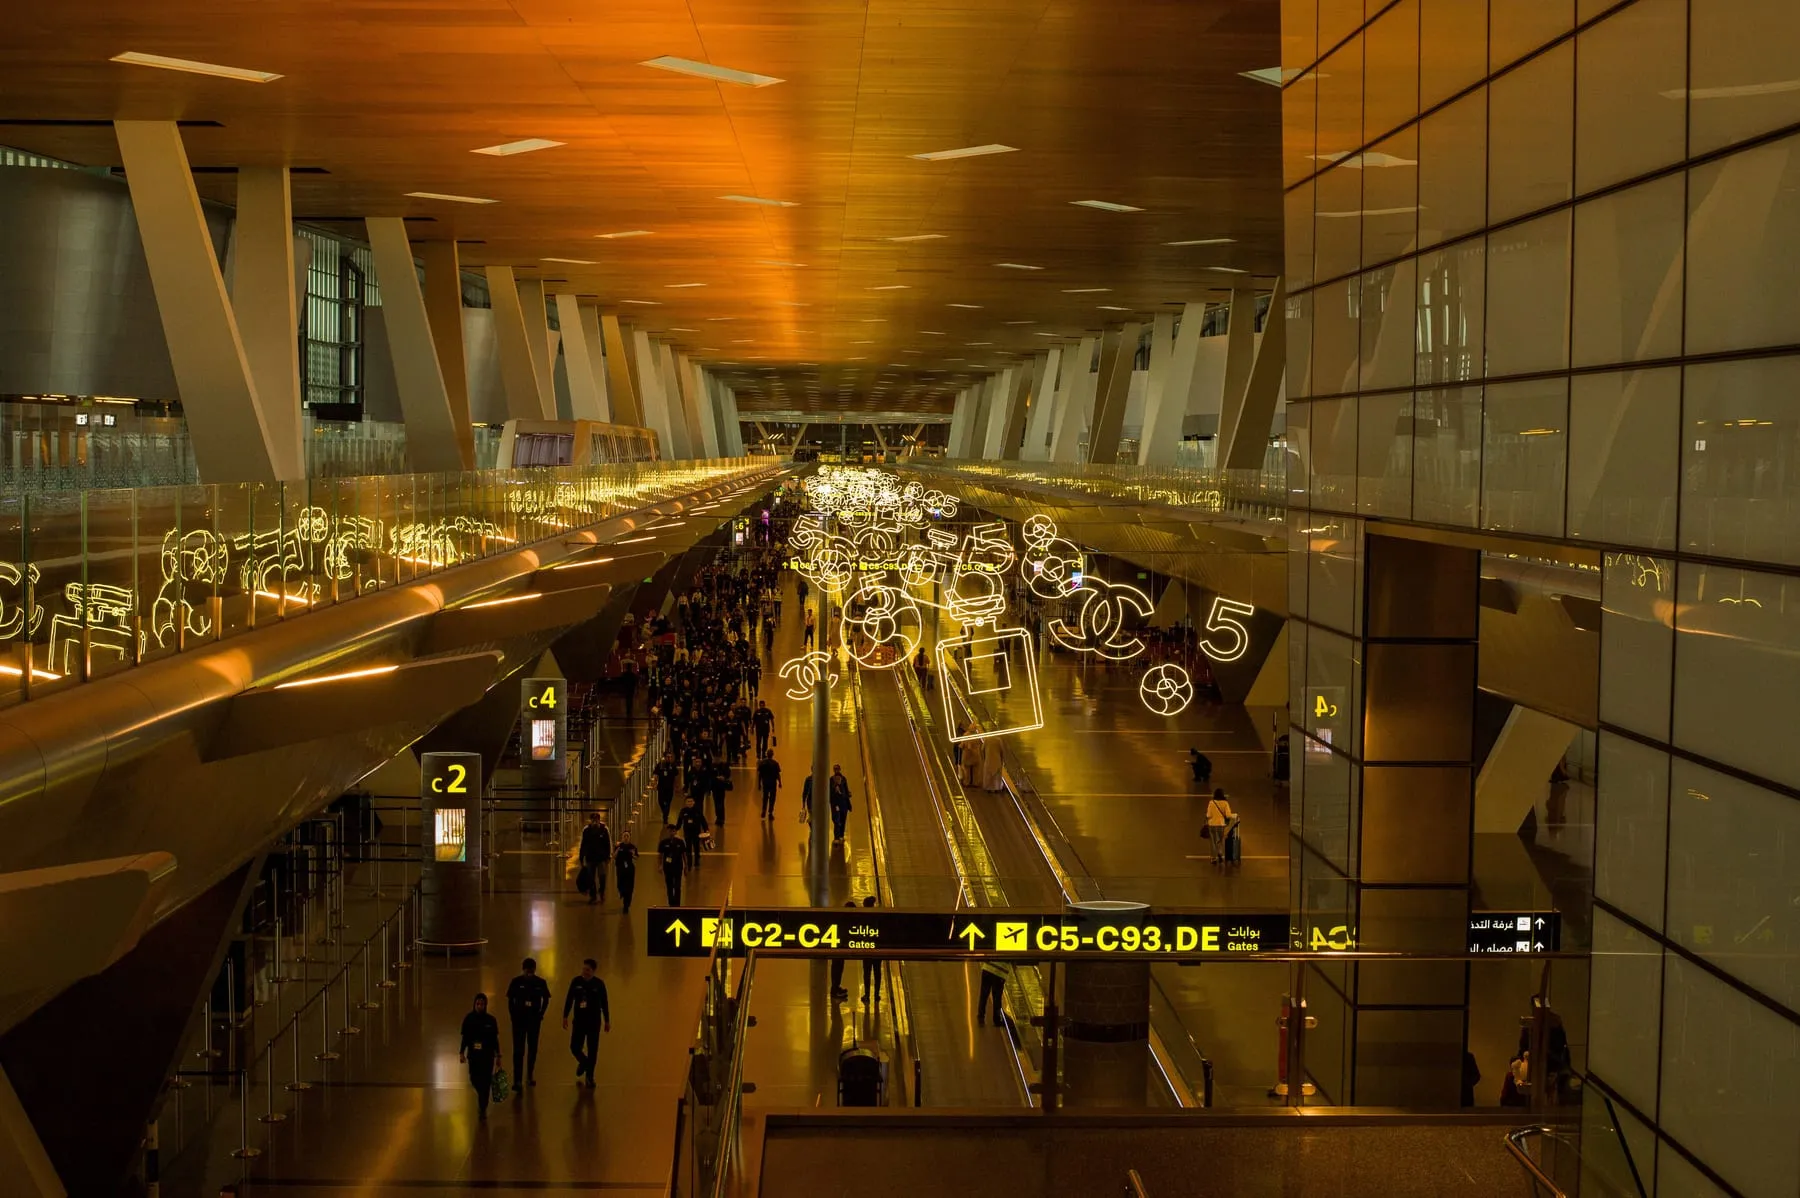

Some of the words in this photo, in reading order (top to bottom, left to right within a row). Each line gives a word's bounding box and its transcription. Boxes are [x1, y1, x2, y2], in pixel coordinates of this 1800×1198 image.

[1199, 596, 1255, 662] 5
[529, 687, 557, 709] c4
[431, 764, 467, 793] c2
[848, 925, 880, 937] بوابات
[1492, 920, 1514, 931] غرفة
[740, 923, 841, 948] C2-C4
[1227, 926, 1260, 939] بوابات
[848, 940, 876, 949] Gates
[1227, 941, 1259, 951] Gates
